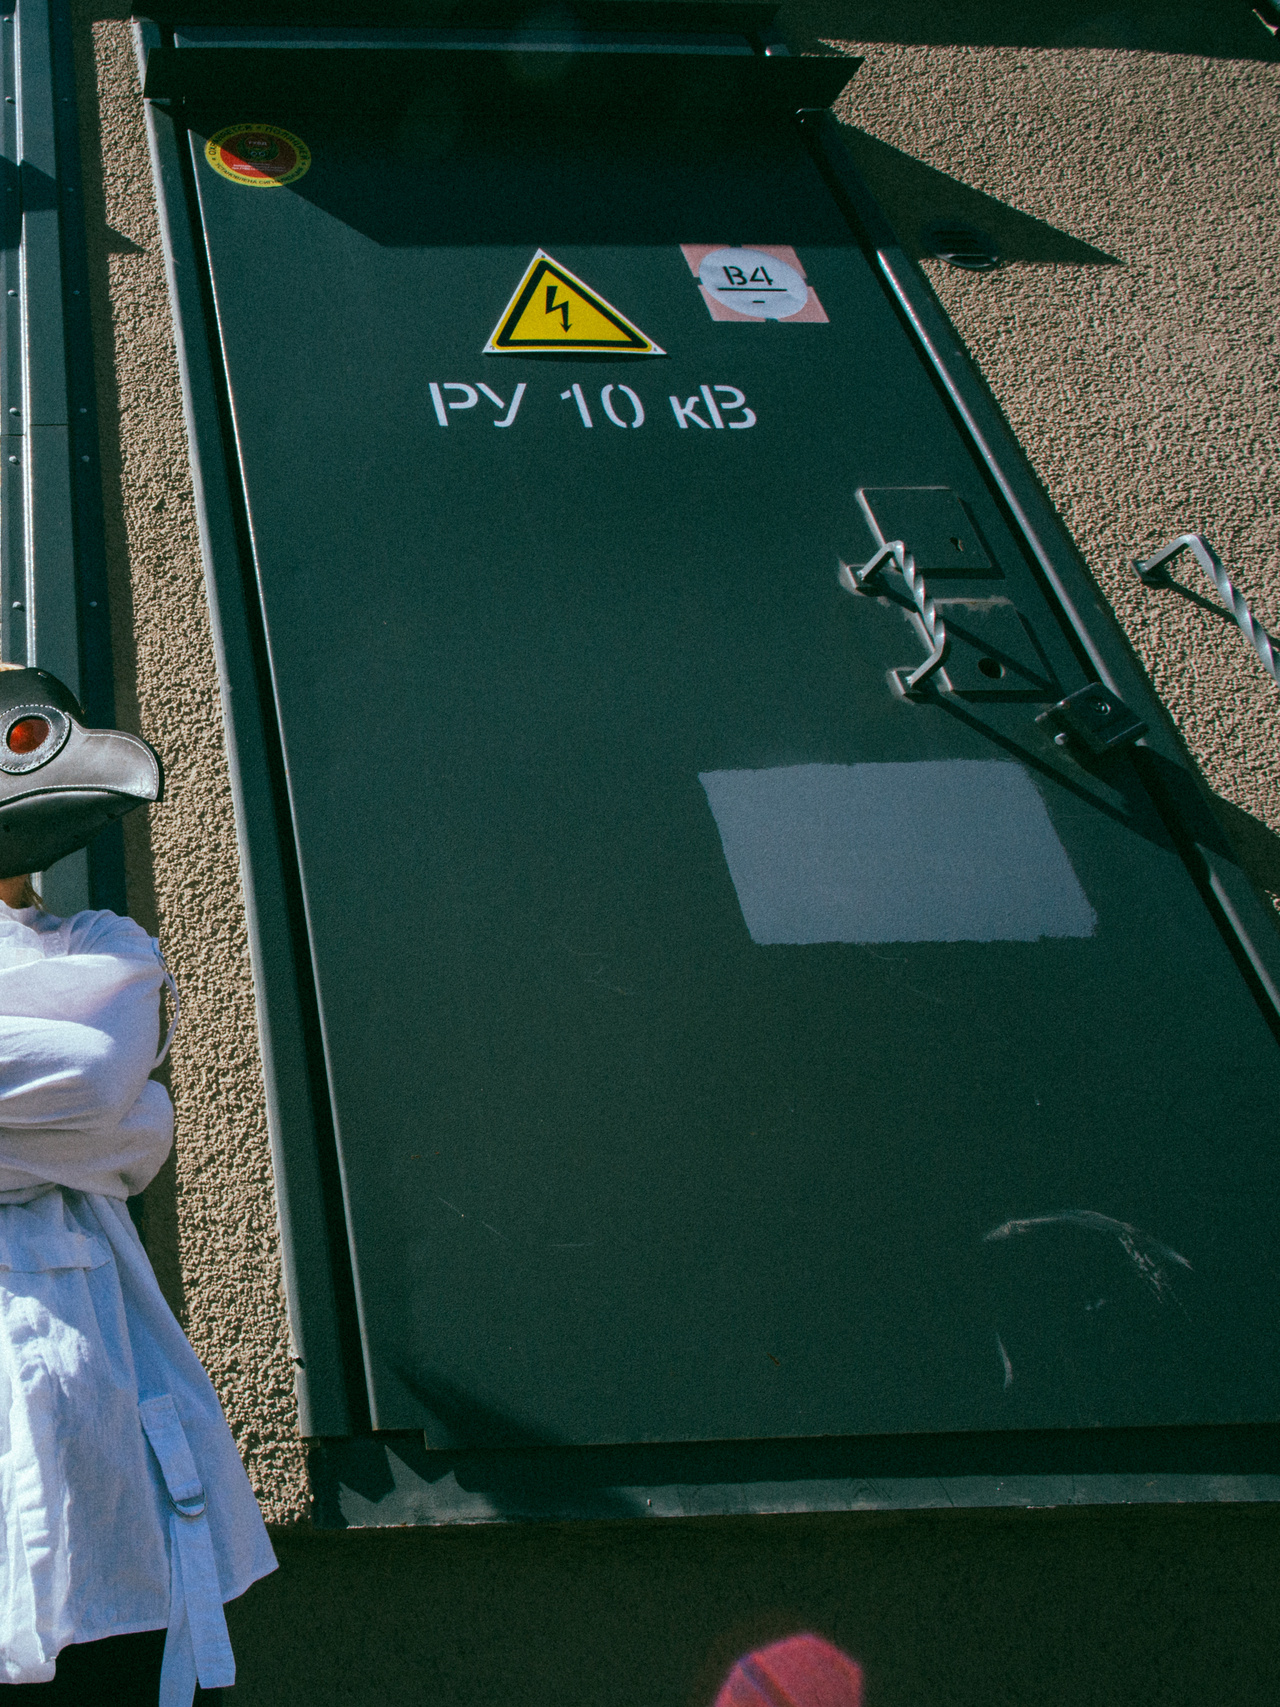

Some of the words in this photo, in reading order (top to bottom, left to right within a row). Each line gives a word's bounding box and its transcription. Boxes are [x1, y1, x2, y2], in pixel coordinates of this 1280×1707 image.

[265, 125, 310, 161] ПОЛИЦИЕЙ
[722, 265, 774, 286] В4
[428, 382, 527, 428] РУ
[560, 383, 645, 429] 10
[669, 384, 757, 429] кВ
